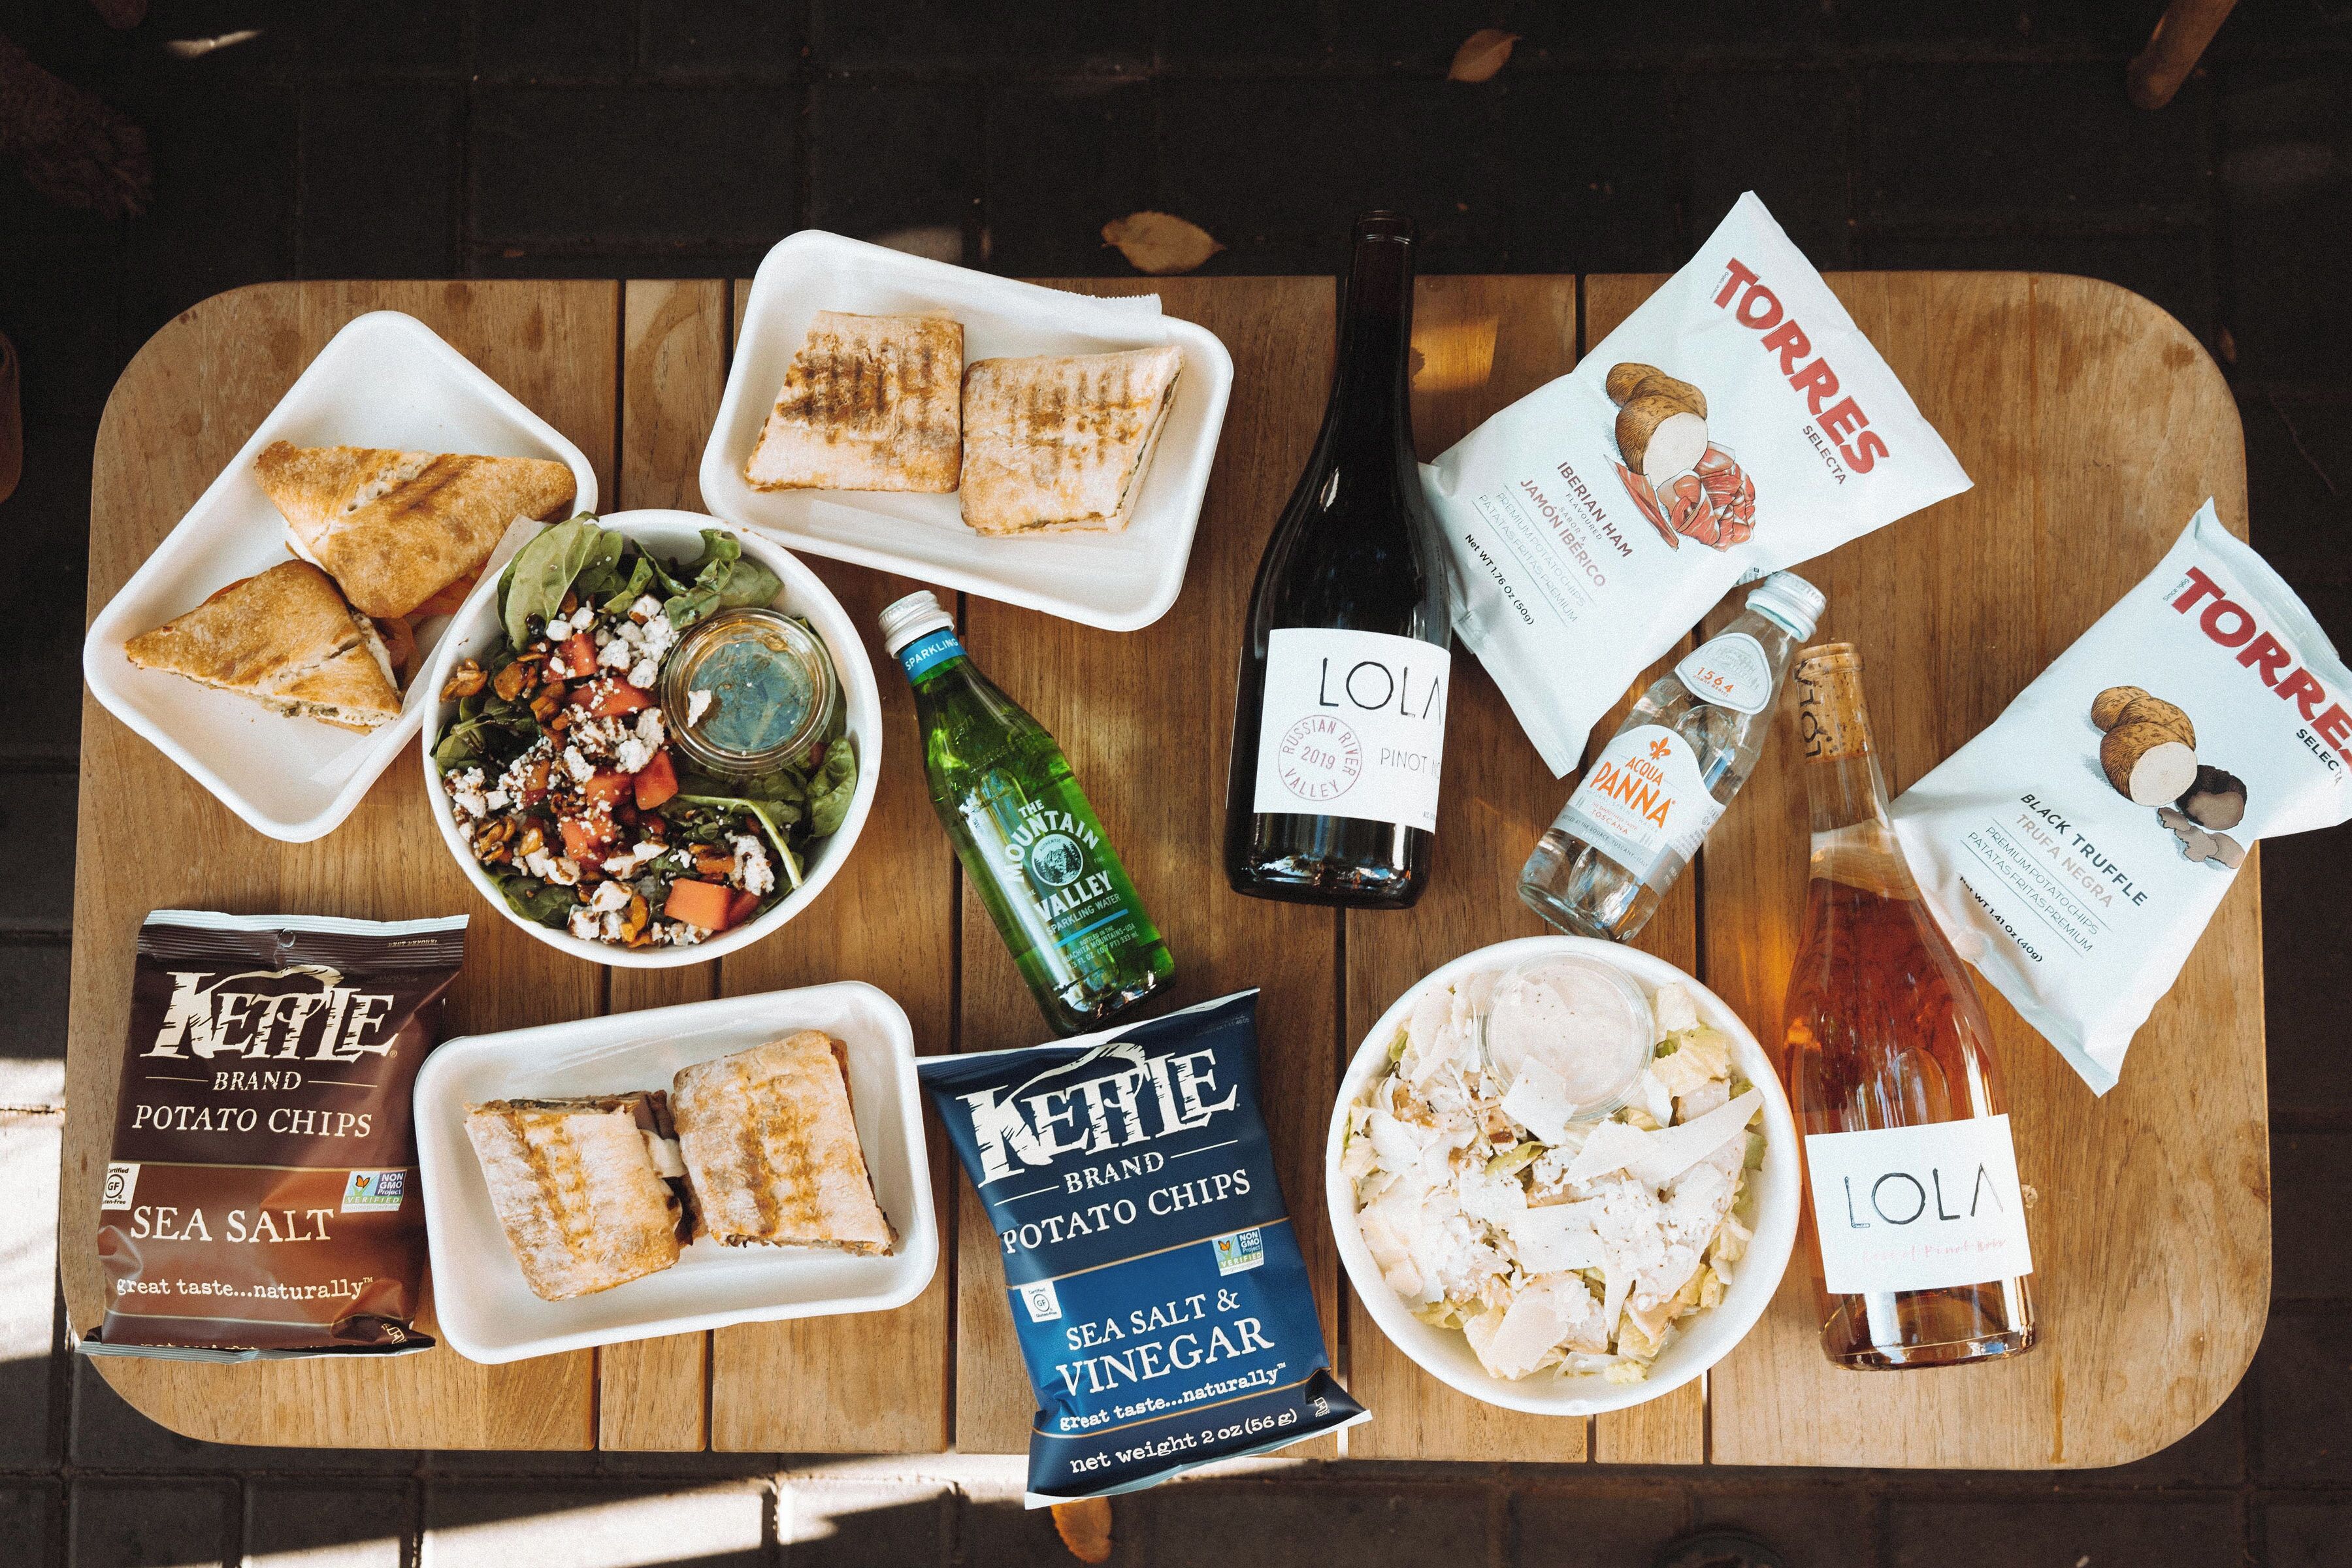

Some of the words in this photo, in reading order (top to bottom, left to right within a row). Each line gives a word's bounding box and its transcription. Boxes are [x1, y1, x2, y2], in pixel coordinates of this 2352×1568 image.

[1712, 257, 1889, 474] TORRES
[1803, 425, 1846, 486] SELECTA
[1496, 493, 1533, 540] PREMIUM
[1520, 480, 1563, 529] JAMÓN
[1559, 528, 1606, 587] IBÉRICO
[1558, 461, 1607, 522] IBERIAN
[1603, 521, 1633, 559] HAM
[1559, 506, 1581, 533] SABOR
[1565, 493, 1602, 540] FLAVOURED
[1465, 534, 1480, 551] Net
[1479, 551, 1494, 566] WT
[1490, 566, 1506, 585] 1.76
[1504, 586, 1515, 599] Oz
[1513, 600, 1534, 625] (50g)
[1478, 495, 1515, 540] PATATAS
[1541, 574, 1578, 621] PREMIUM
[905, 638, 958, 670] SPARKLING
[1320, 657, 1441, 725] LOLA
[1697, 666, 1734, 693] 1564
[1282, 719, 1337, 755] RUSSIAN
[1338, 730, 1360, 777] RIVER
[1301, 745, 1336, 770] 2019
[1380, 747, 1428, 774] PINOT
[1625, 757, 1664, 786] ACQUA
[1284, 768, 1339, 798] VALLEY
[1590, 761, 1671, 828] PANNA
[1019, 799, 1045, 818] THE
[1591, 809, 1628, 835] TOSCANA
[1004, 810, 1100, 883] MOUNTAIN
[1039, 838, 1061, 851] AUTHENTIC
[2016, 814, 2060, 859] TRUFA
[2061, 857, 2114, 907] NEGRA
[2020, 794, 2071, 834] BLACK
[2071, 833, 2148, 906] TRUFFLE
[1033, 870, 1113, 922] VALLEY
[1968, 832, 2012, 875] PATATAS
[2010, 872, 2047, 908] FRITAS
[2044, 906, 2093, 952] PREMIUM
[1985, 826, 2031, 871] PREMIUM
[2029, 868, 2069, 906] POTATO
[2067, 904, 2099, 934] CHIPS
[1047, 905, 1094, 936] SPARKLING
[1095, 893, 1121, 911] WATER
[1079, 932, 1100, 946] BOTTLED
[1106, 925, 1115, 934] THE
[1974, 893, 1989, 907] WT
[1989, 909, 2005, 925] 1.41
[2005, 924, 2017, 938] Oz
[2017, 938, 2042, 962] (40g)
[1079, 956, 1086, 965] FL
[1086, 951, 1095, 961] OZ
[1110, 939, 1120, 951] PT)
[1121, 934, 1132, 944] 333
[140, 965, 399, 1064] KETTLE
[212, 1071, 301, 1091] BRAND
[132, 1105, 257, 1132] POTATO
[268, 1109, 371, 1138] CHIPS
[956, 1043, 1239, 1188] KETTLE
[108, 1182, 120, 1190] GF
[1066, 1151, 1164, 1194] BRAND
[1844, 1163, 2003, 1229] LOLA
[131, 1205, 212, 1241] SEA
[227, 1208, 334, 1243] SALT
[1002, 1200, 1136, 1254] POTATO
[1149, 1169, 1250, 1215] CHIPS
[1222, 1252, 1262, 1267] VERIFIED
[1239, 1231, 1258, 1241] NON
[1241, 1238, 1260, 1248] GMO
[116, 1278, 171, 1296] great
[1066, 1318, 1124, 1351] SEA
[1131, 1296, 1206, 1335] SALT
[1217, 1288, 1241, 1312] &
[1056, 1317, 1275, 1396] VINEGAR
[1060, 1410, 1110, 1431] great
[1070, 1452, 1111, 1475] net
[1116, 1431, 1198, 1465] weight
[1201, 1430, 1215, 1444] 2
[1218, 1424, 1243, 1439] oz
[1278, 1408, 1298, 1426] g)
